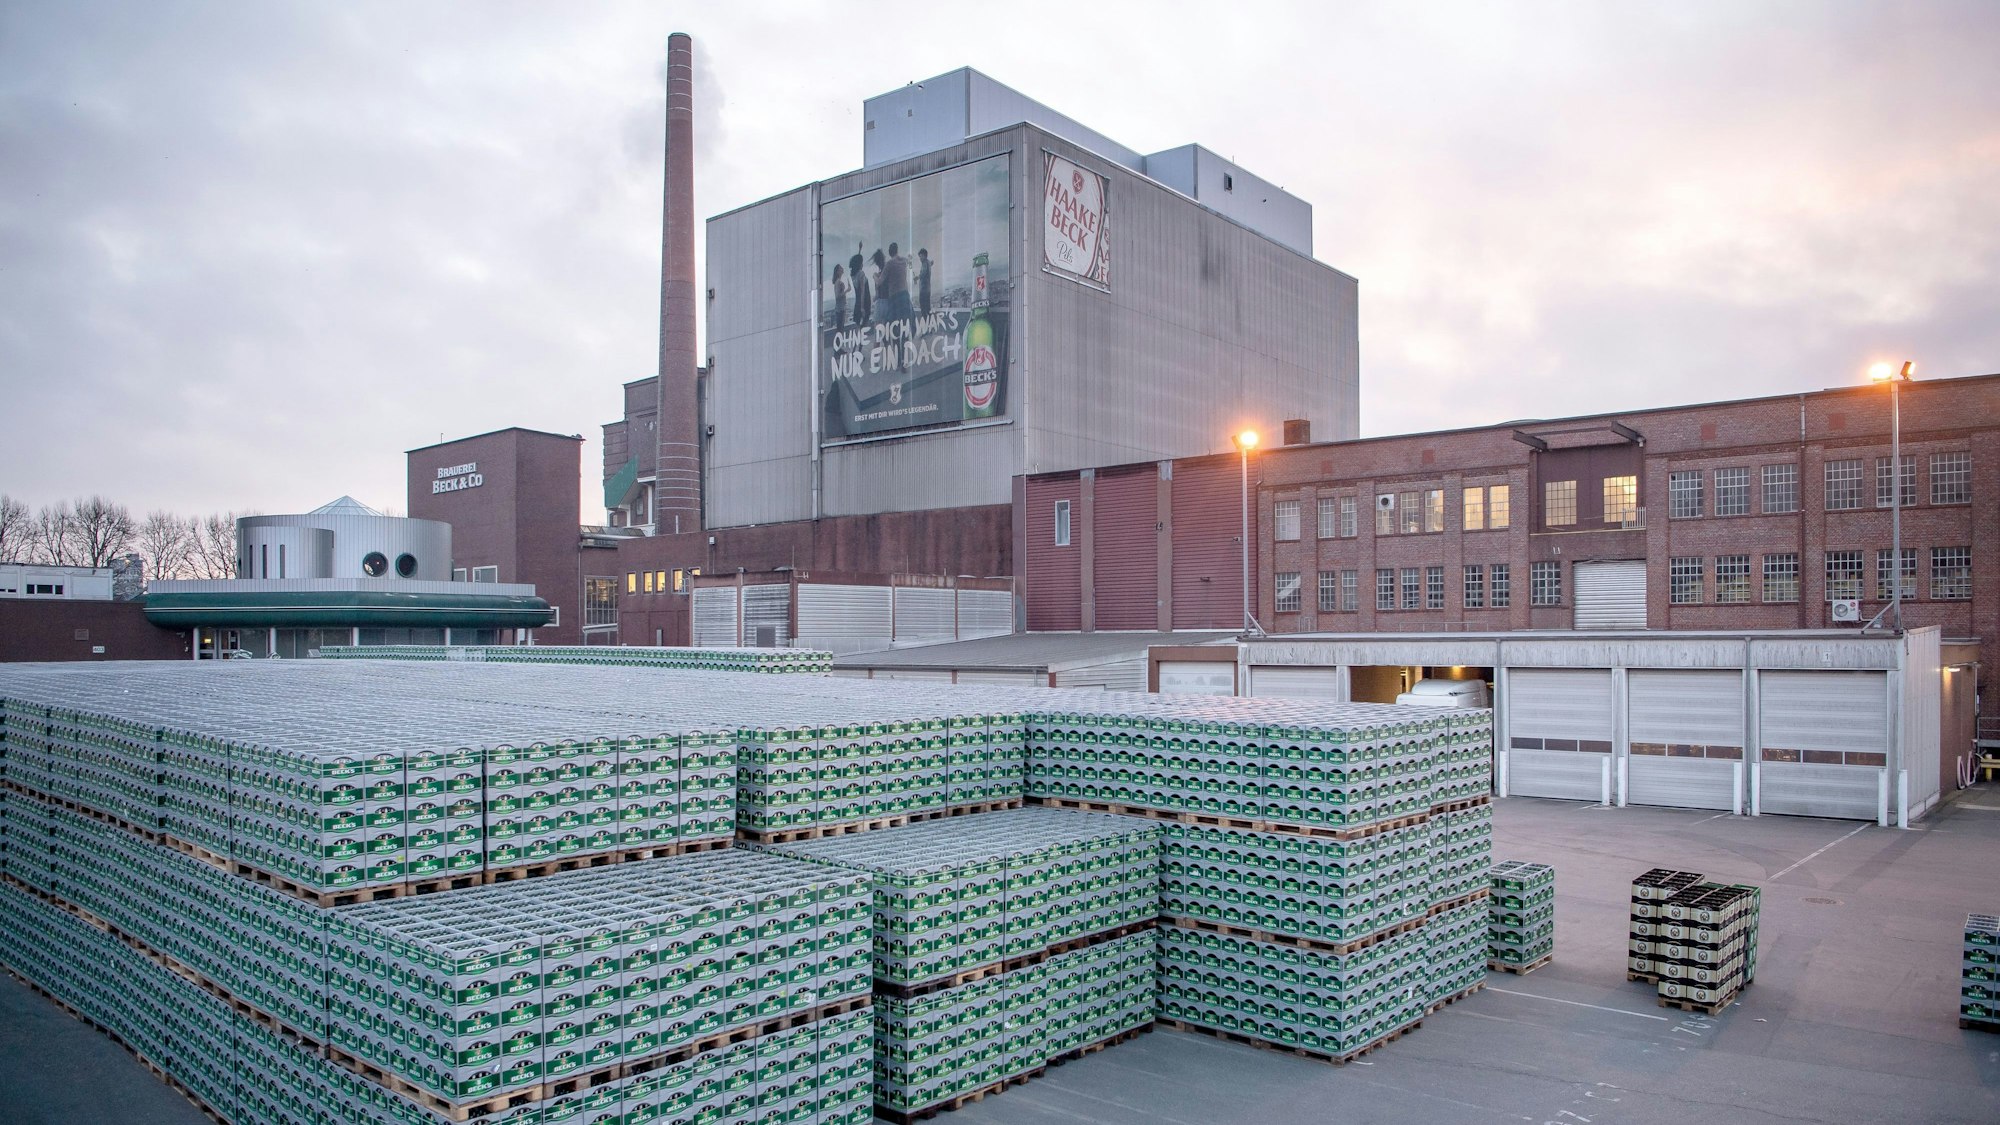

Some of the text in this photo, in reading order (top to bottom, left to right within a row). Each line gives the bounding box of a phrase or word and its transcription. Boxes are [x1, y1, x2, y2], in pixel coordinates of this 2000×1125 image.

[1050, 177, 1096, 233] HAAKE
[1051, 205, 1088, 252] BECK
[1057, 240, 1073, 263] Pils
[833, 310, 958, 352] OHNE DICH WÄR'S
[831, 332, 961, 382] NUR EIN DACH
[965, 370, 997, 383] BECK'S
[888, 408, 907, 416] WIRD'S
[908, 404, 938, 414] LEGENDÄR.
[438, 462, 476, 478] BRAUEREI
[433, 478, 458, 493] BECK
[459, 477, 468, 489] &
[416, 760, 437, 768] BECK'S
[332, 766, 355, 775] BECK'S
[375, 843, 397, 851] BECK'S
[375, 870, 397, 878] BECK'S
[334, 876, 357, 884] BECK'S
[731, 909, 749, 918] BECK'S
[698, 916, 717, 924] BECK'S
[794, 922, 810, 930] BECK'S
[764, 928, 781, 936] BECK'S
[731, 935, 749, 944] BECK'S
[824, 940, 840, 948] BECK'S
[666, 951, 685, 960] BECK'S
[794, 947, 810, 956] BECK'S
[509, 953, 532, 963] BECK'S
[764, 954, 780, 962] BECK'S
[630, 959, 650, 968] BECK'S
[592, 966, 613, 976] BECK'S
[698, 968, 716, 978] BECK'S
[794, 971, 810, 980] BECK'S
[552, 975, 574, 985] BECK'S
[666, 978, 686, 988] BECK'S
[764, 979, 780, 988] BECK'S
[509, 982, 532, 993] BECK'S
[732, 986, 750, 996] BECK'S
[852, 982, 866, 990] BECK'S
[466, 991, 490, 1002] BECK'S
[630, 987, 650, 997] BECK'S
[592, 995, 613, 1005] BECK'S
[699, 994, 717, 1004] BECK'S
[553, 1004, 575, 1014] BECK'S
[667, 1004, 686, 1015] BECK'S
[763, 1004, 780, 1013] BECK'S
[510, 1012, 533, 1022] BECK'S
[631, 1014, 651, 1024] BECK'S
[732, 1012, 750, 1021] BECK'S
[467, 1022, 491, 1033] BECK'S
[593, 1023, 613, 1033] BECK'S
[699, 1020, 717, 1030] BECK'S
[553, 1032, 575, 1043] BECK'S
[668, 1031, 687, 1042] BECK'S
[510, 1041, 533, 1052] BECK'S
[631, 1041, 651, 1052] BECK'S
[467, 1052, 492, 1063] BECK'S
[593, 1050, 614, 1061] BECK'S
[554, 1061, 576, 1072] BECK'S
[511, 1070, 534, 1082] BECK'S
[468, 1081, 492, 1093] BECK'S
[697, 1088, 716, 1099] BECK'S
[764, 1094, 780, 1104] BECK'S
[667, 1101, 686, 1113] BECK'S
[731, 1103, 748, 1114] BECK'S
[631, 1112, 651, 1124] BECK'S
[794, 1108, 811, 1119] BECK'S
